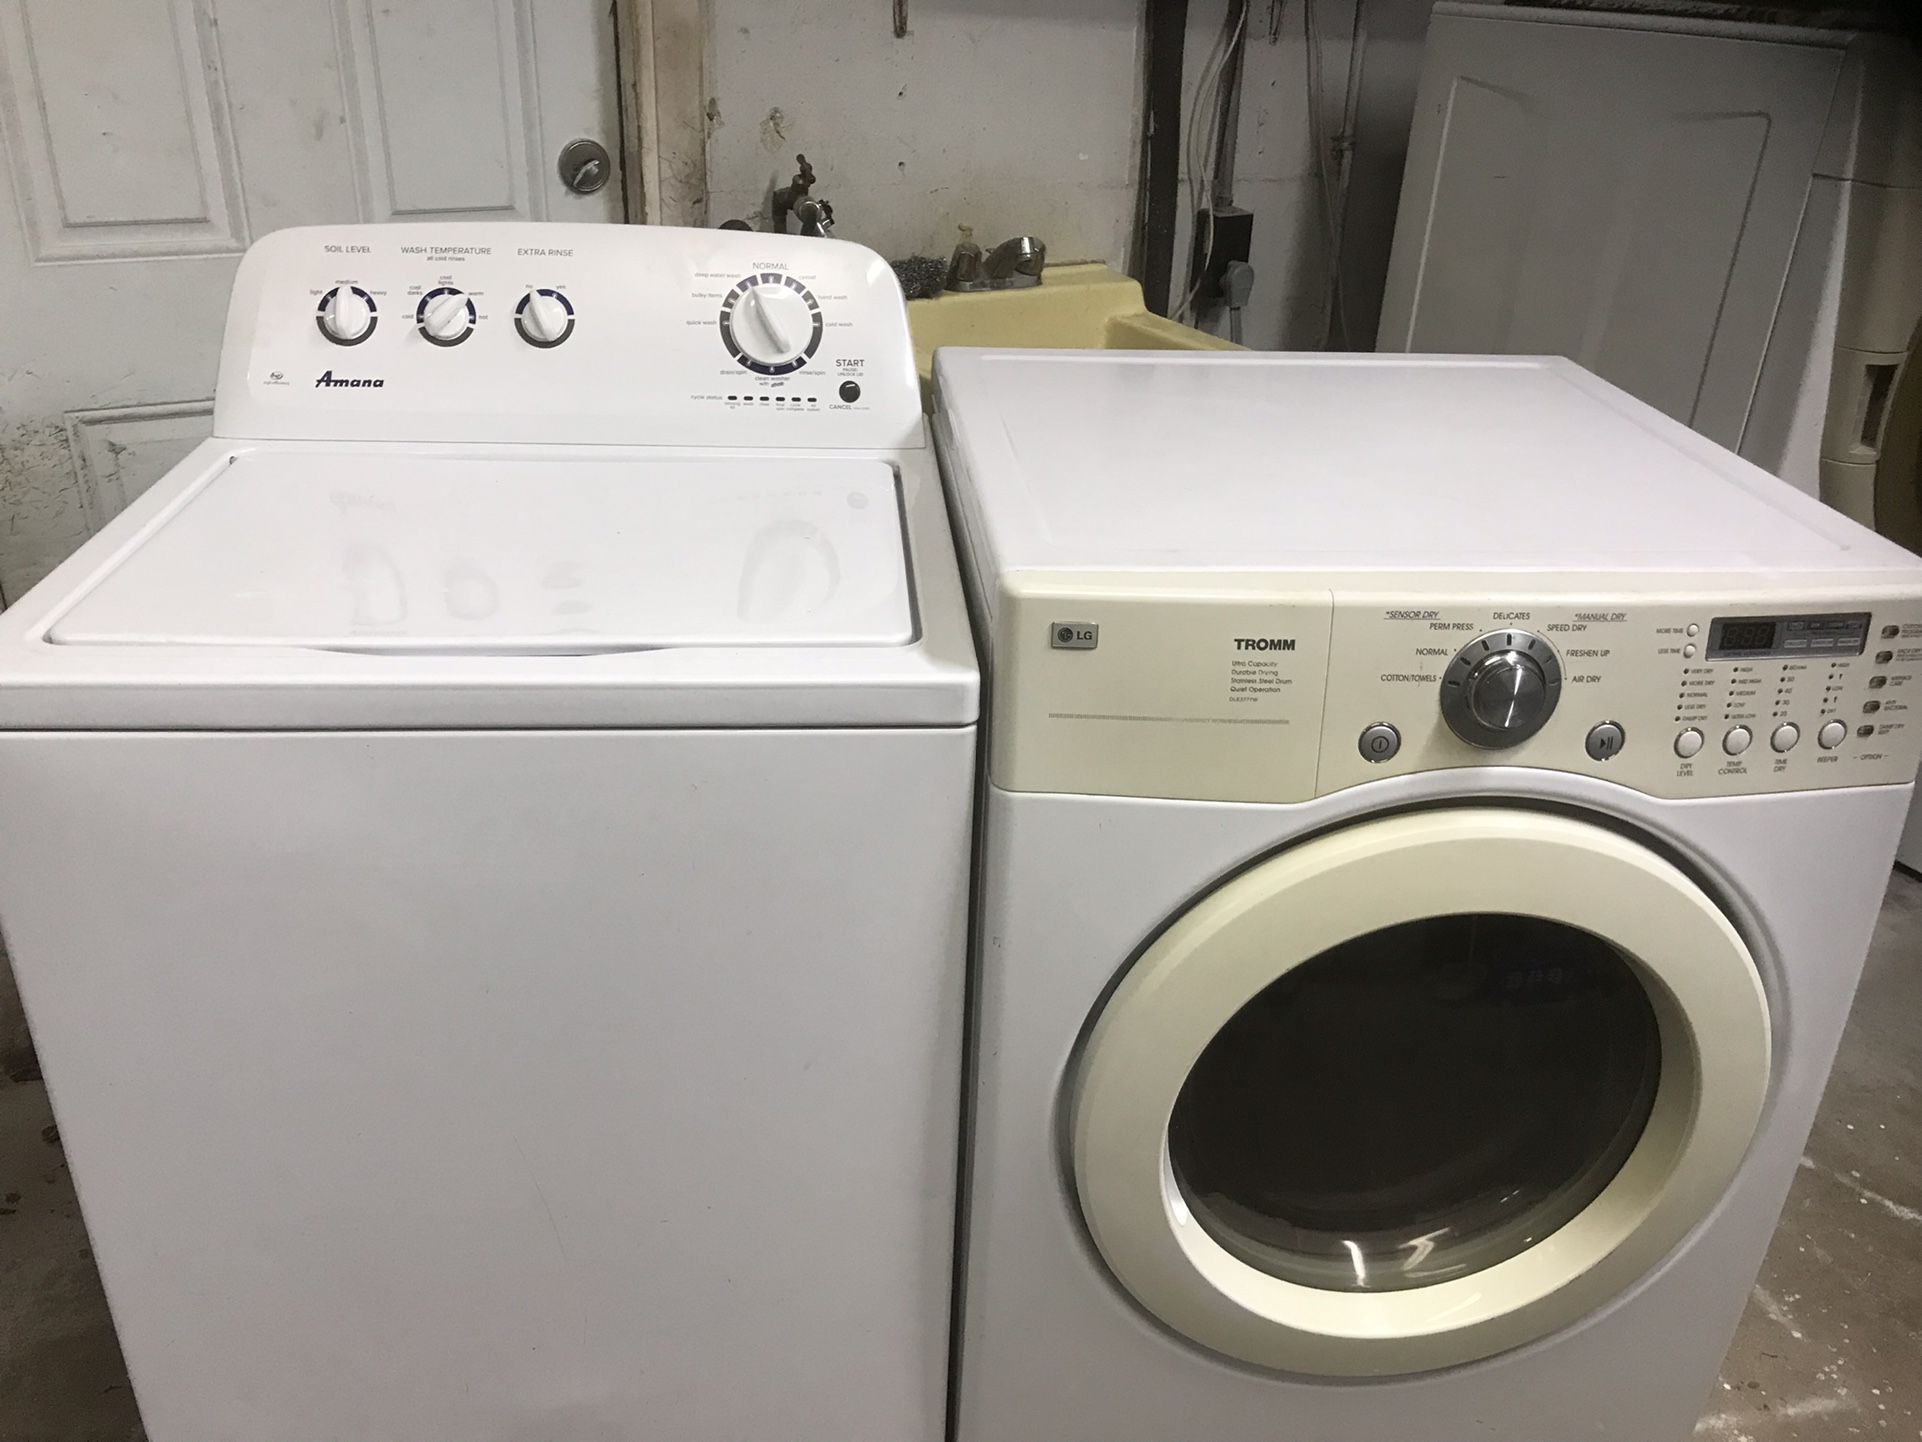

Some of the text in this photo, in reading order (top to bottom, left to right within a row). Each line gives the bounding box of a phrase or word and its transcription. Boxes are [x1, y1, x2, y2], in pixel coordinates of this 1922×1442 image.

[324, 245, 371, 253] SOIL LEVEL
[401, 246, 491, 255] WASH TEMPERATURE
[517, 248, 546, 256] EXTRA
[752, 262, 789, 270] NORMAL
[835, 359, 865, 367] START
[315, 370, 384, 388] Amana
[1422, 611, 1440, 619] DRY
[1493, 612, 1530, 620] DELICATES
[1610, 612, 1627, 621] DRY
[1429, 622, 1474, 631] PERM PRESS
[1546, 624, 1588, 632] SPEED DRY
[1077, 631, 1092, 640] LG
[1234, 638, 1296, 651] TROMM
[1415, 648, 1448, 656] NORMAL
[1566, 649, 1610, 657] FRESHEN UP
[1247, 660, 1278, 668] Capacity
[1258, 669, 1279, 677] Drying
[1380, 674, 1437, 682] COTTON/TOWELS
[1718, 767, 1748, 775] CONTROL
